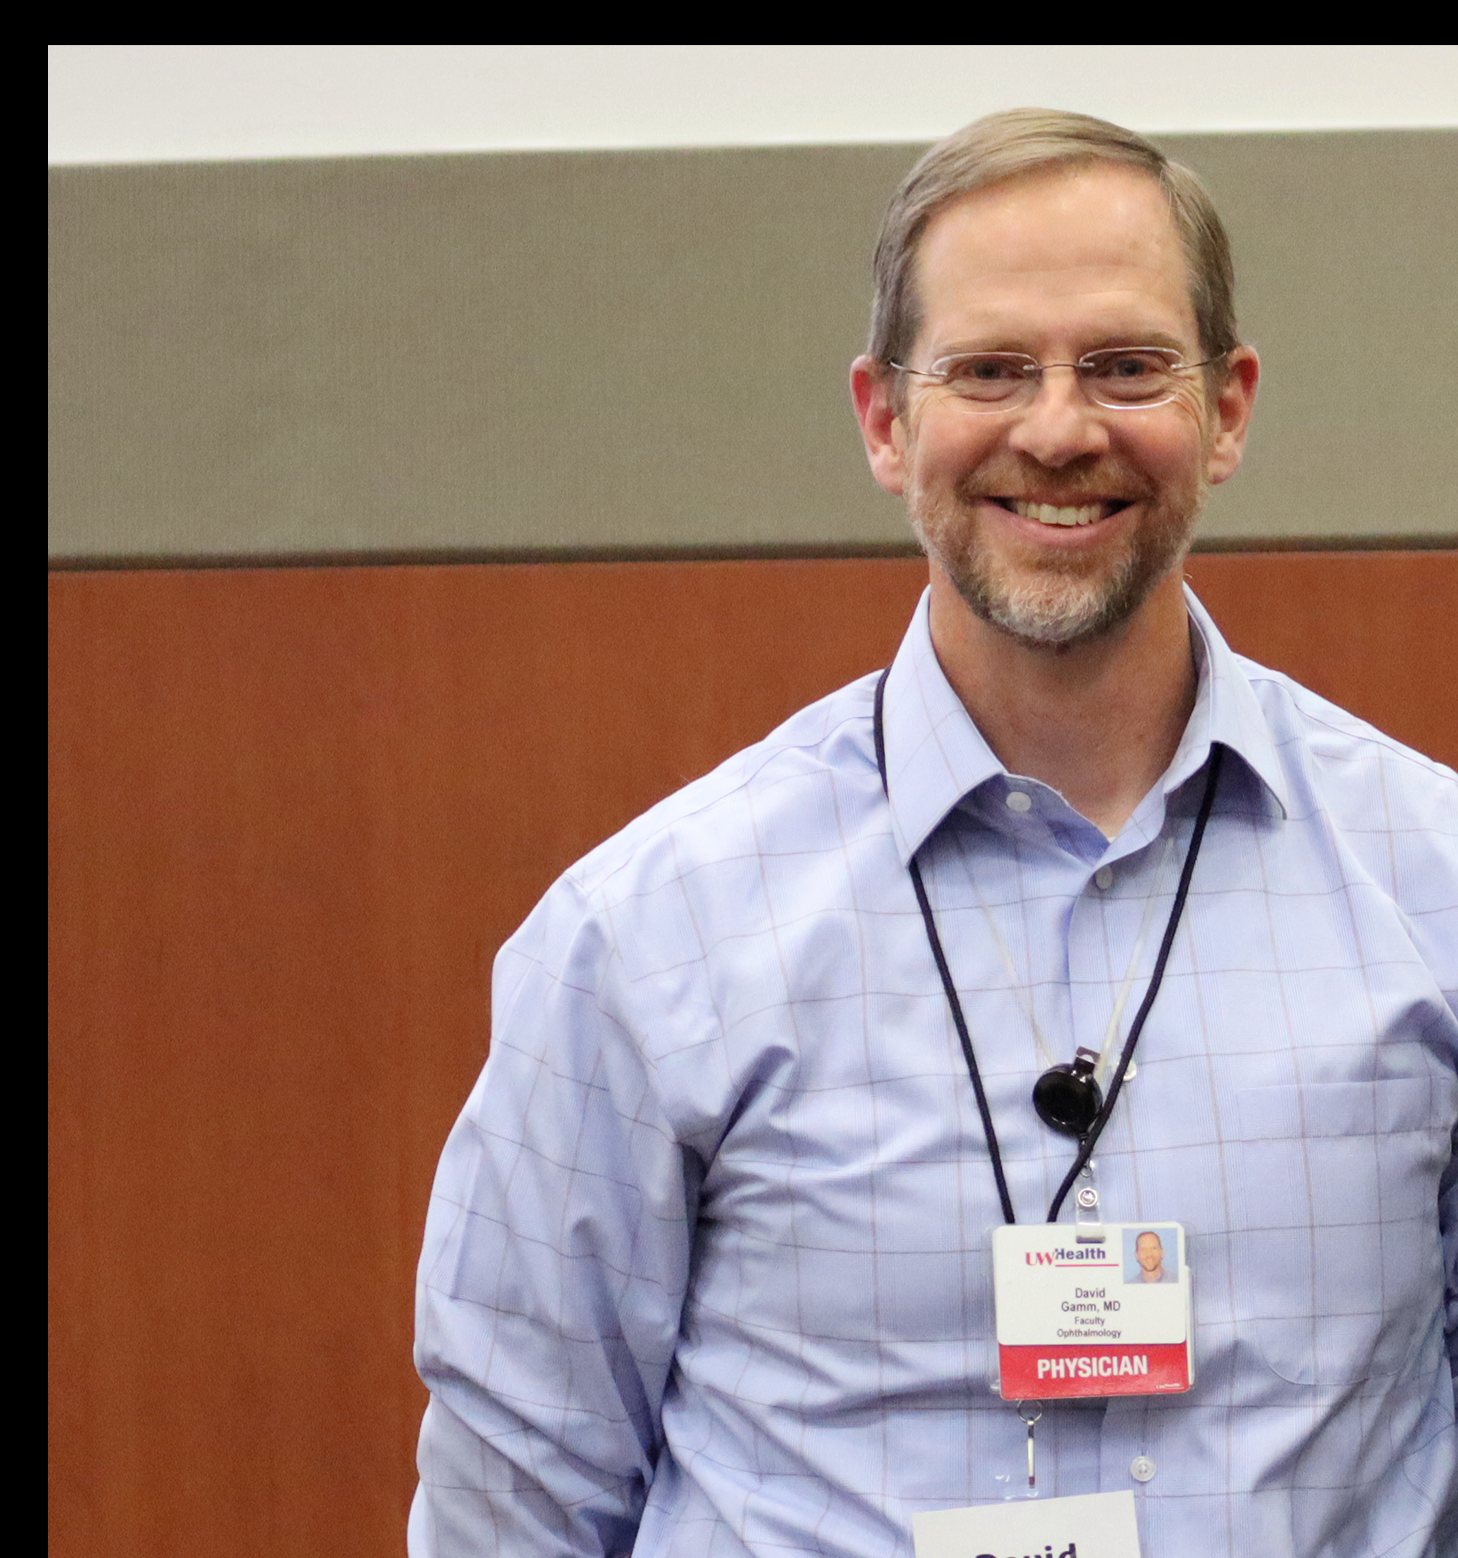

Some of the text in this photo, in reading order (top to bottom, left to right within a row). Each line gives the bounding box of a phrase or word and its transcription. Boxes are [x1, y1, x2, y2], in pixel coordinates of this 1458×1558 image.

[1074, 1287, 1106, 1299] David
[1061, 1300, 1121, 1313] Gamm, MD
[1074, 1316, 1106, 1326] Faculty
[1056, 1328, 1122, 1339] Ophthalmology
[1037, 1354, 1148, 1380] PHYSICIAN
